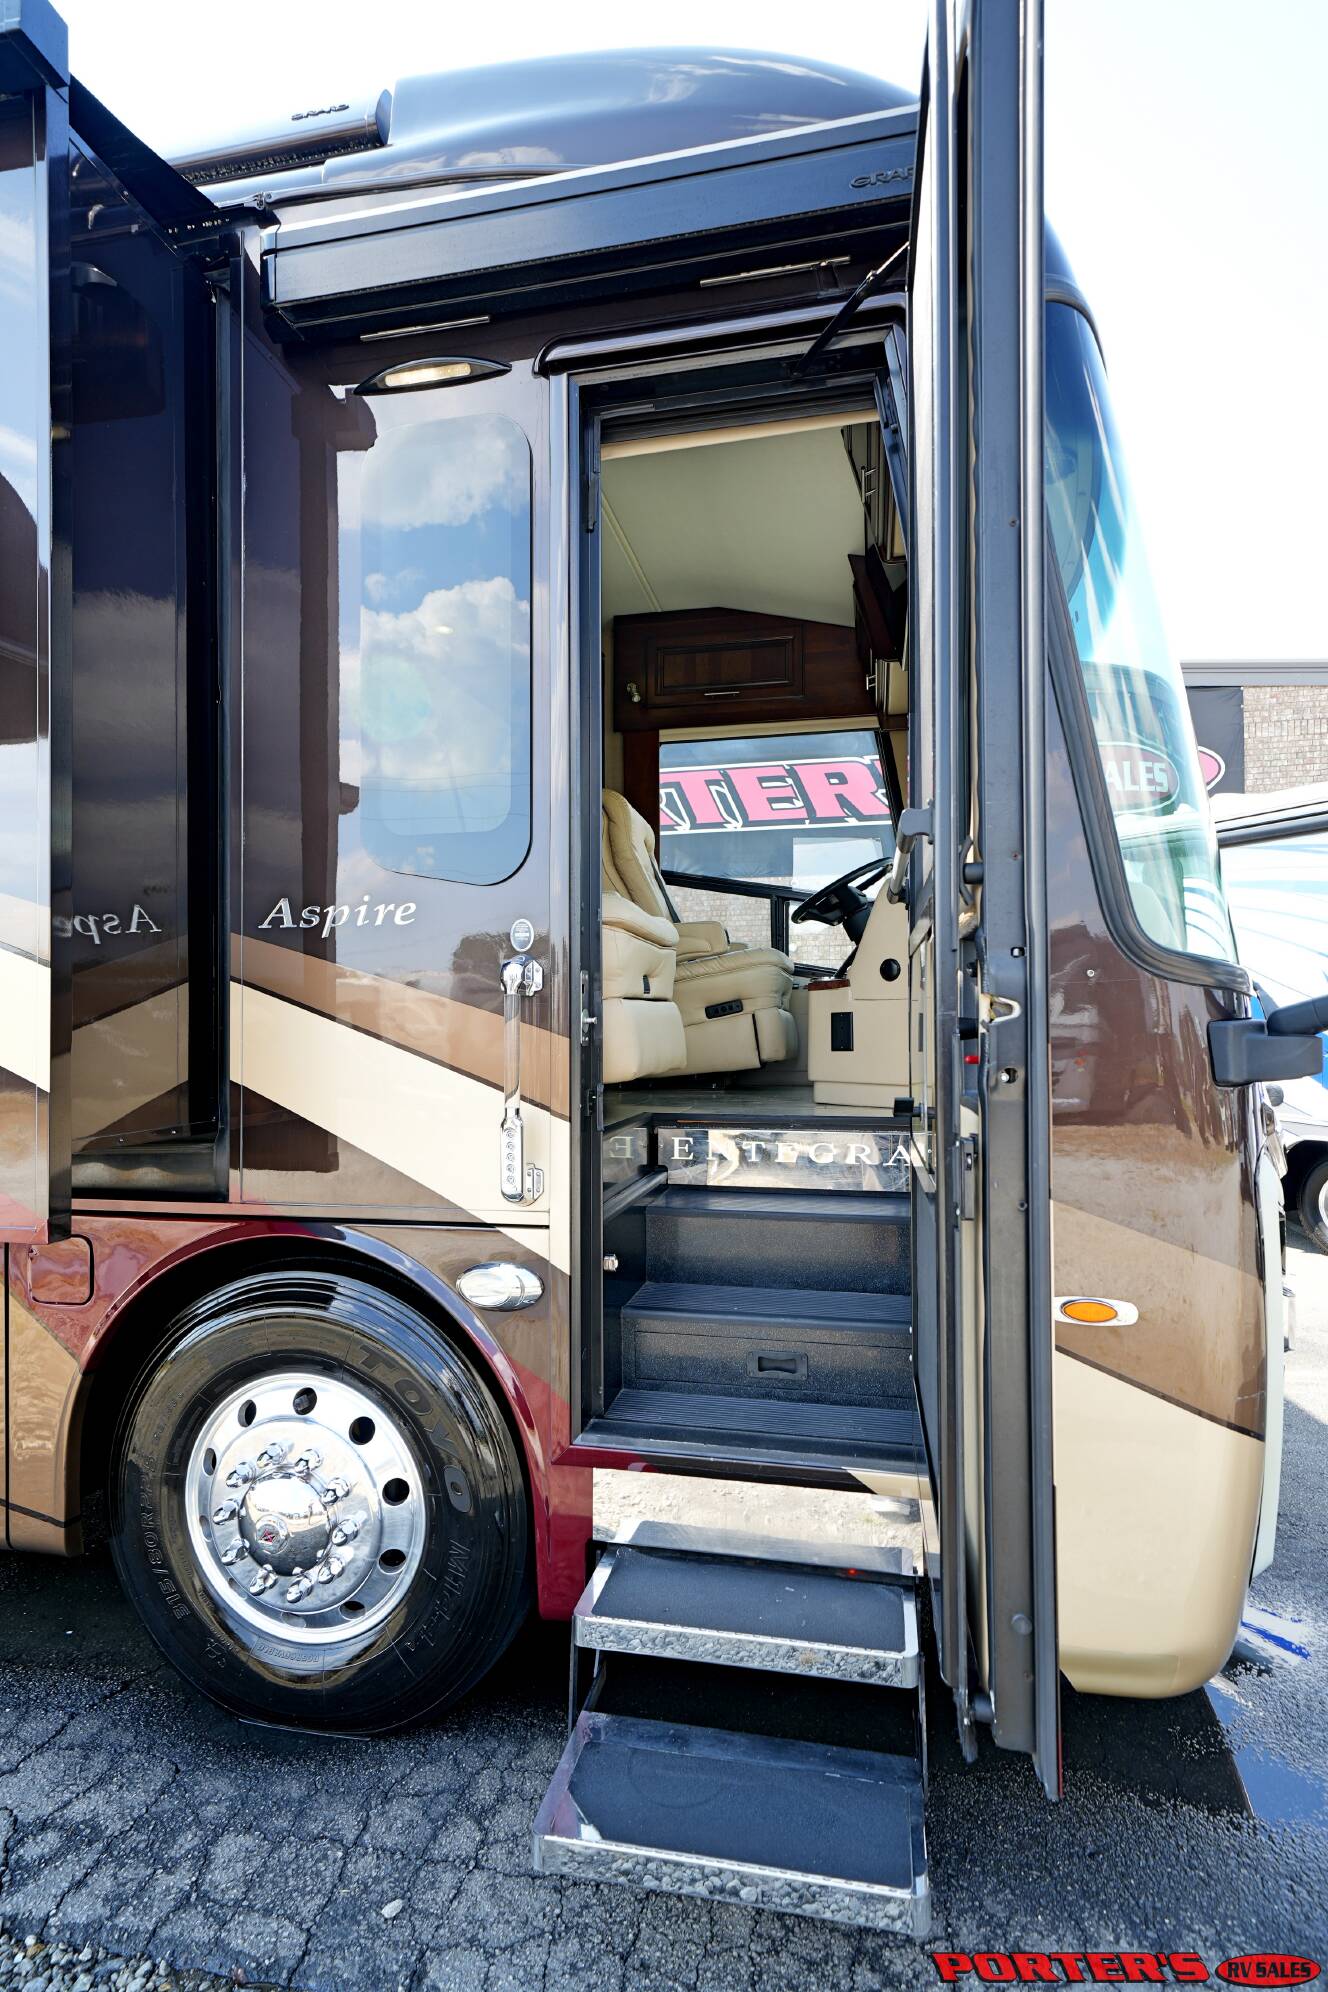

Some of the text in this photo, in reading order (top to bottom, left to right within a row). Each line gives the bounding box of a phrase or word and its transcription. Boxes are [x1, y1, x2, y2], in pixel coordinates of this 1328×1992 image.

[257, 894, 417, 939] Aspire
[671, 1136, 923, 1168] ENTEGRA
[359, 1344, 474, 1514] TOYO
